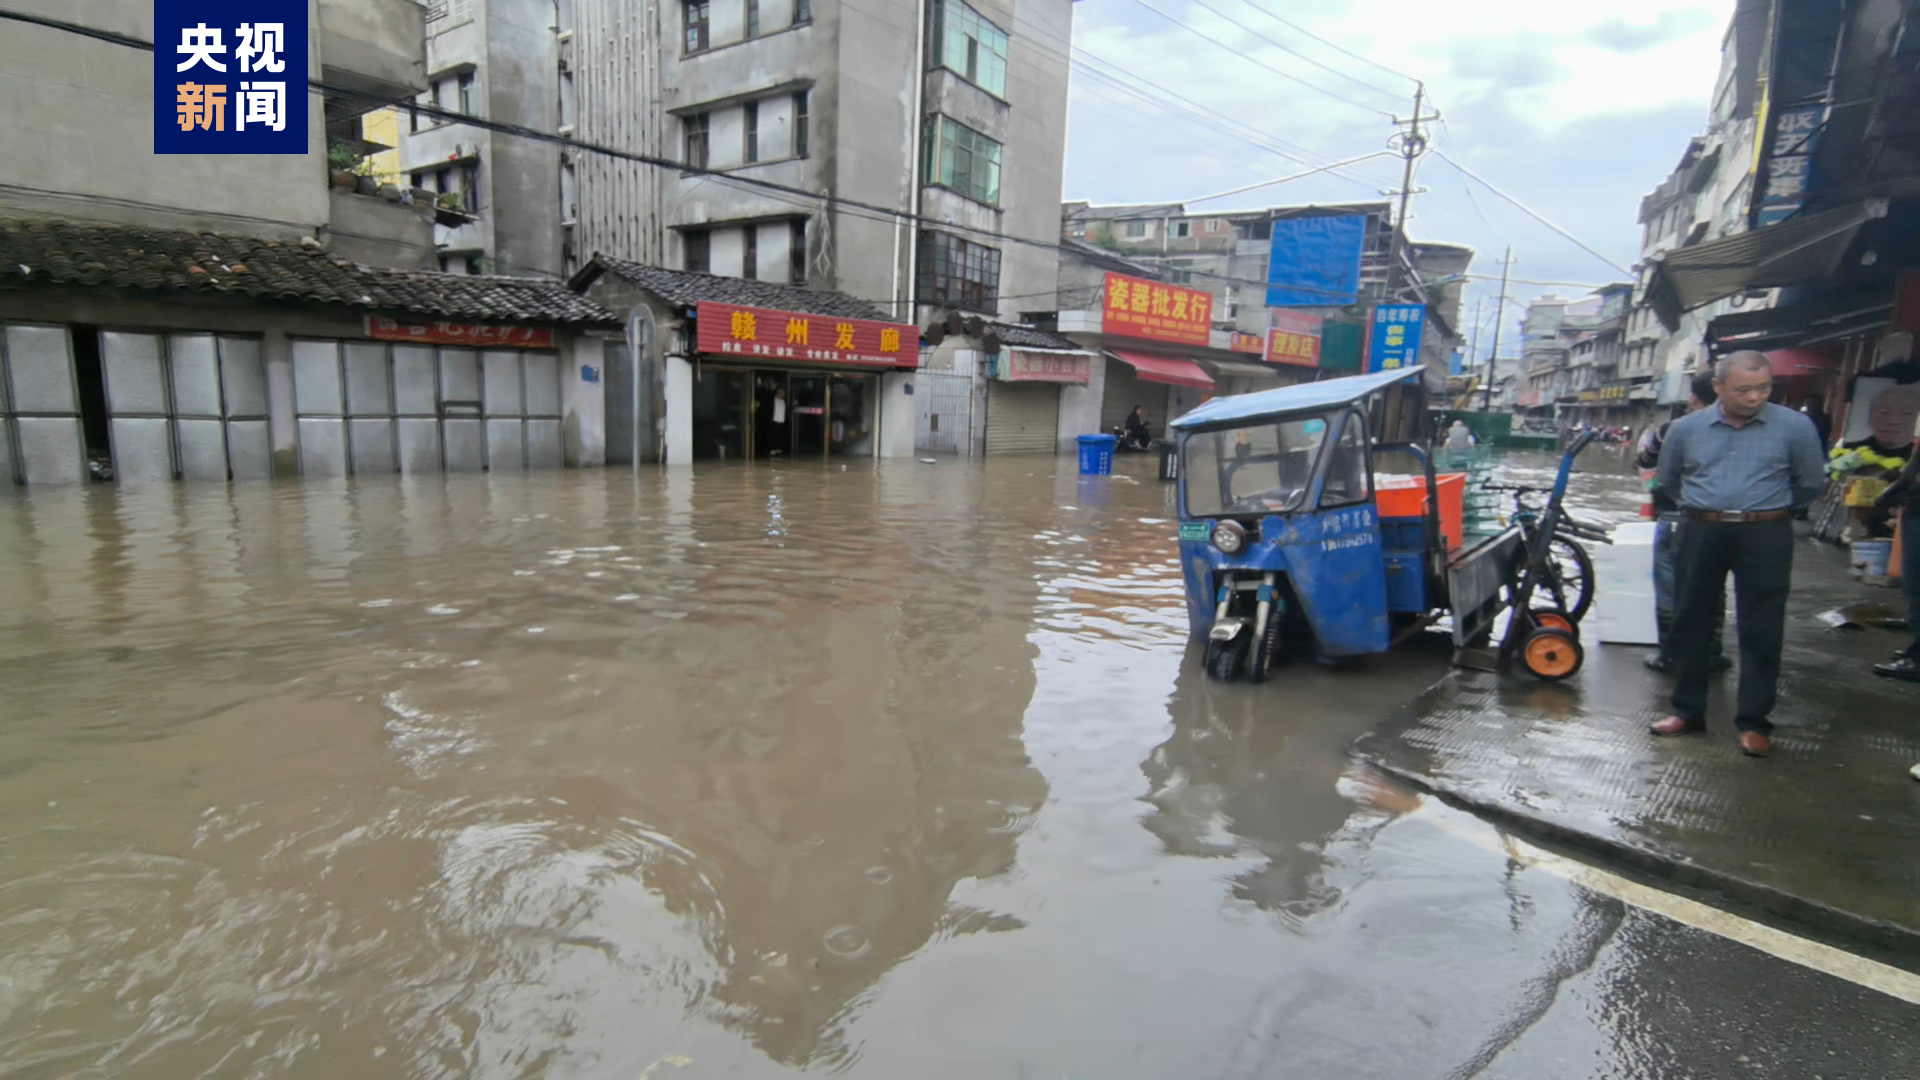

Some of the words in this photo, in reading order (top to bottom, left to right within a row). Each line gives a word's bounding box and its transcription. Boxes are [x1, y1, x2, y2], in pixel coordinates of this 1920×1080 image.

[1109, 278, 1208, 323] 瓷器批发行
[731, 311, 900, 353] 赣州发廊
[1273, 332, 1315, 358] 理发店
